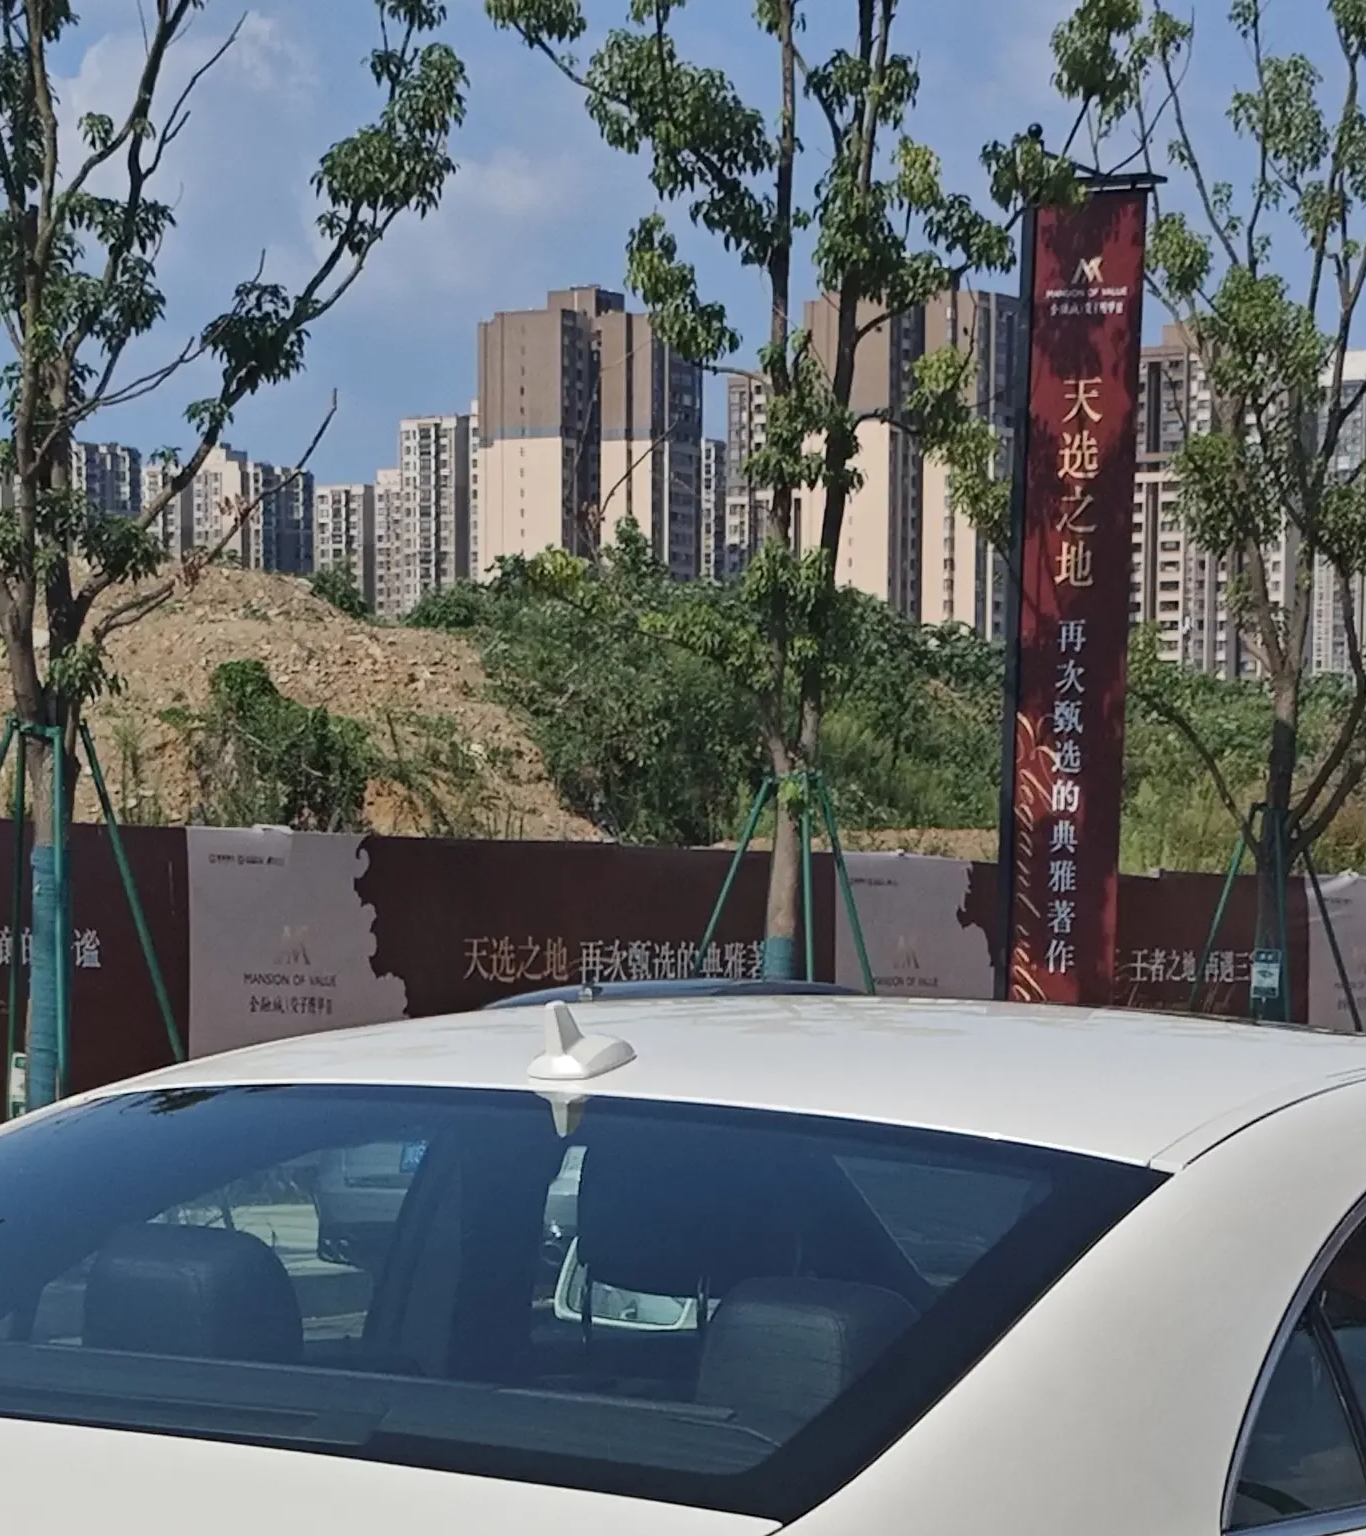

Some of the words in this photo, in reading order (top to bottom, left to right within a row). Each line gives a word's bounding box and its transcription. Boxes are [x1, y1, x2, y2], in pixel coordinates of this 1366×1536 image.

[1054, 378, 1103, 588] 天选之地
[1045, 618, 1087, 975] 再次甄选的典雅著作
[464, 936, 568, 982] 天选之地
[1130, 949, 1197, 983] 王者之地
